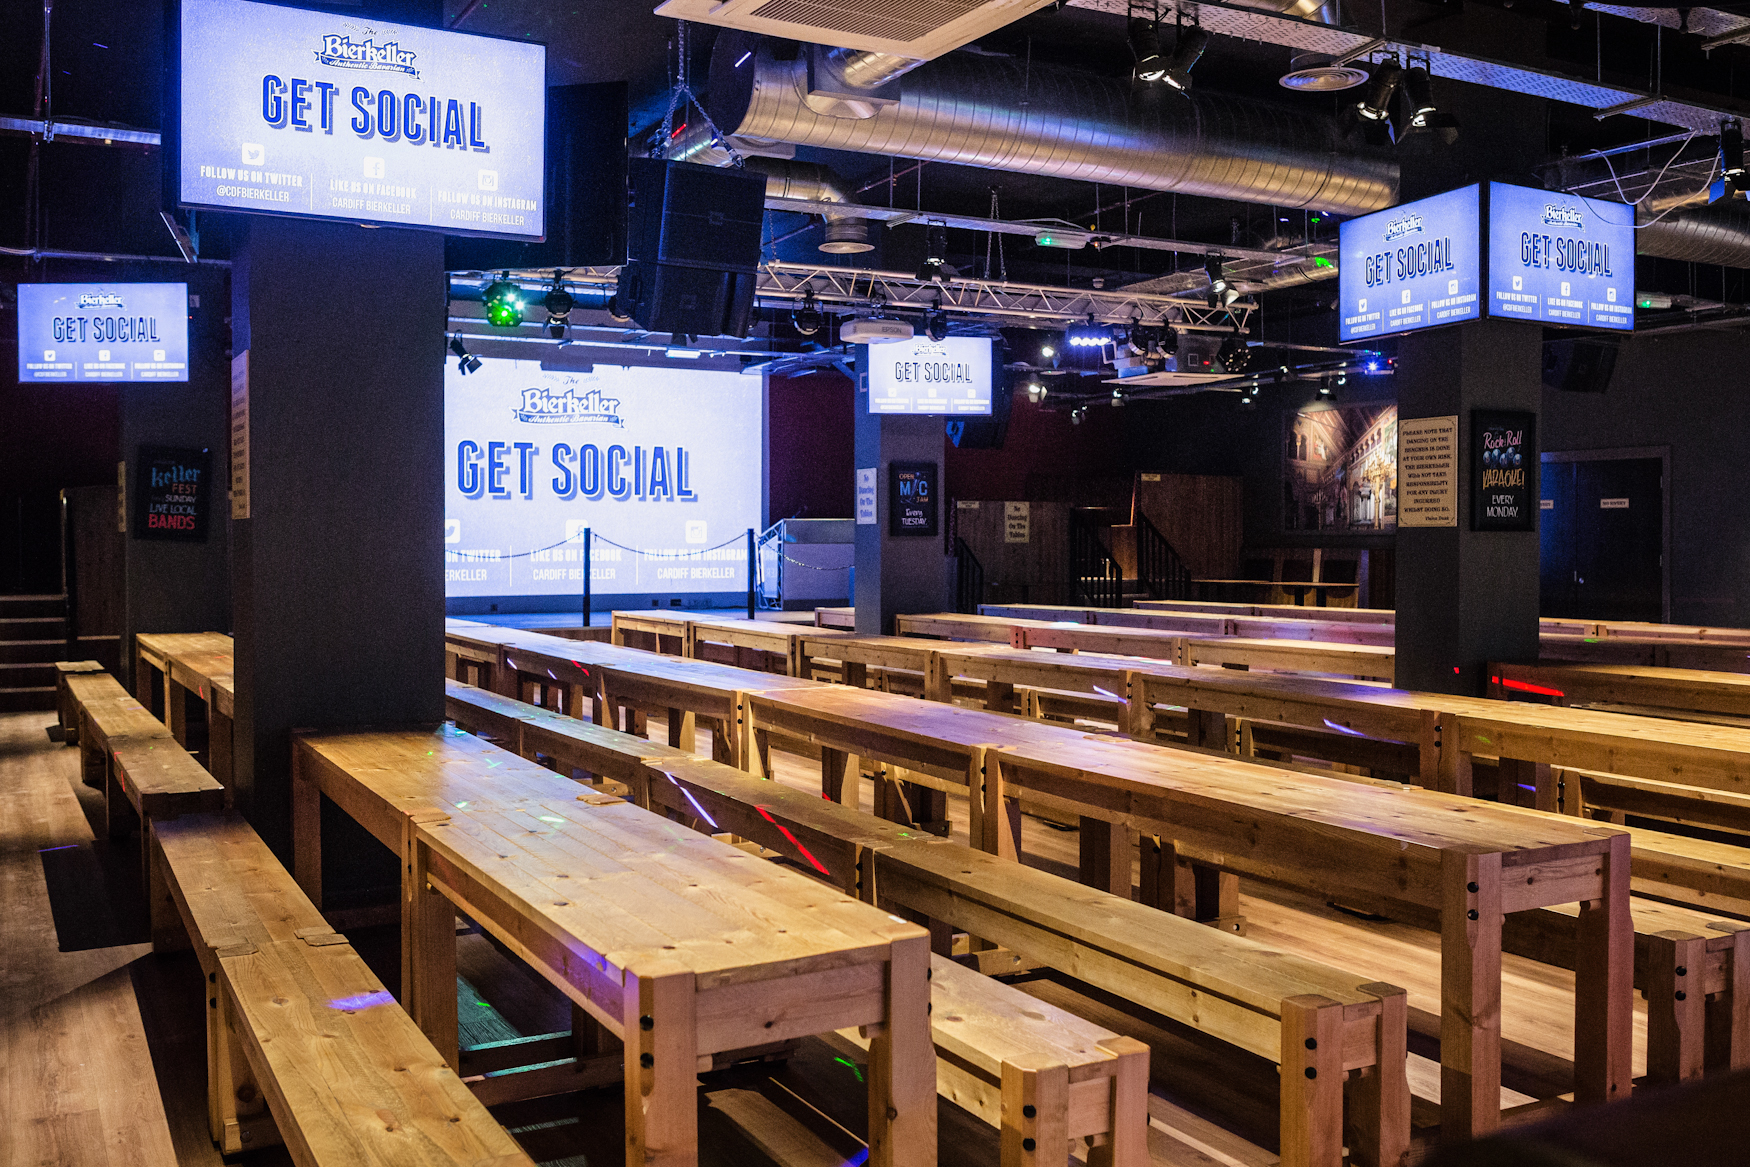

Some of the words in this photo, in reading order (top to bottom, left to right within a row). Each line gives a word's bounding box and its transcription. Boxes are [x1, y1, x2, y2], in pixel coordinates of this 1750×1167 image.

[323, 35, 416, 66] Bierkeller
[329, 59, 368, 70] Authentic
[262, 74, 338, 134] GET
[351, 86, 490, 153] SOCIAL
[200, 165, 236, 180] FOLLOW
[238, 169, 249, 182] US
[250, 171, 263, 183] ON
[264, 172, 303, 187] TWITTER
[216, 185, 290, 203] @CDFBIERKELLER
[330, 179, 349, 192] LIKE
[350, 181, 362, 193] US
[362, 182, 374, 195] ON
[376, 184, 417, 199] FACEBOOK
[332, 197, 365, 211] CARDIFF
[365, 199, 411, 215] BIERKELLER
[438, 190, 470, 205] FOLLOW
[470, 194, 481, 206] US
[482, 195, 494, 207] ON
[494, 196, 537, 212] INSTAGRAM
[450, 208, 481, 222] CARDIFF
[482, 211, 525, 226] BIERKELLER
[1364, 251, 1392, 287] GET
[1396, 236, 1454, 280] SOCIAL
[1520, 231, 1551, 267] GET
[1555, 237, 1612, 278] SOCIAL
[53, 315, 87, 342] GET
[93, 315, 160, 342] SOCIAL
[882, 326, 902, 334] EPSON
[562, 375, 579, 385] The
[895, 361, 920, 382] GET
[924, 362, 972, 383] SOCIAL
[522, 388, 620, 414] Bierkeller
[1483, 432, 1503, 449] Rock
[1506, 430, 1522, 447] Roll
[457, 439, 539, 500] GET
[551, 442, 698, 502] SOCIAL
[1482, 468, 1525, 490] KARAOKE!
[165, 493, 197, 503] SUNDAY
[172, 483, 198, 495] FEST
[149, 502, 169, 513] LIVE
[170, 503, 197, 515] LOCAL
[1491, 495, 1514, 505] EVERY
[148, 514, 196, 530] BANDS
[905, 508, 923, 518] Every
[460, 549, 501, 562] TWITTER
[531, 549, 551, 562] LIKE
[552, 549, 564, 562] US
[565, 549, 578, 562] ON
[579, 549, 622, 562] FCEBOOK
[644, 548, 675, 561] FOLLOW
[703, 548, 748, 561] INSTAGRAM
[445, 568, 487, 581] ERKELLER
[533, 568, 567, 581] CARDIFF
[568, 568, 616, 580] BIEELLER
[657, 567, 689, 580] CARDIFF
[690, 567, 735, 579] BIERKELLER
